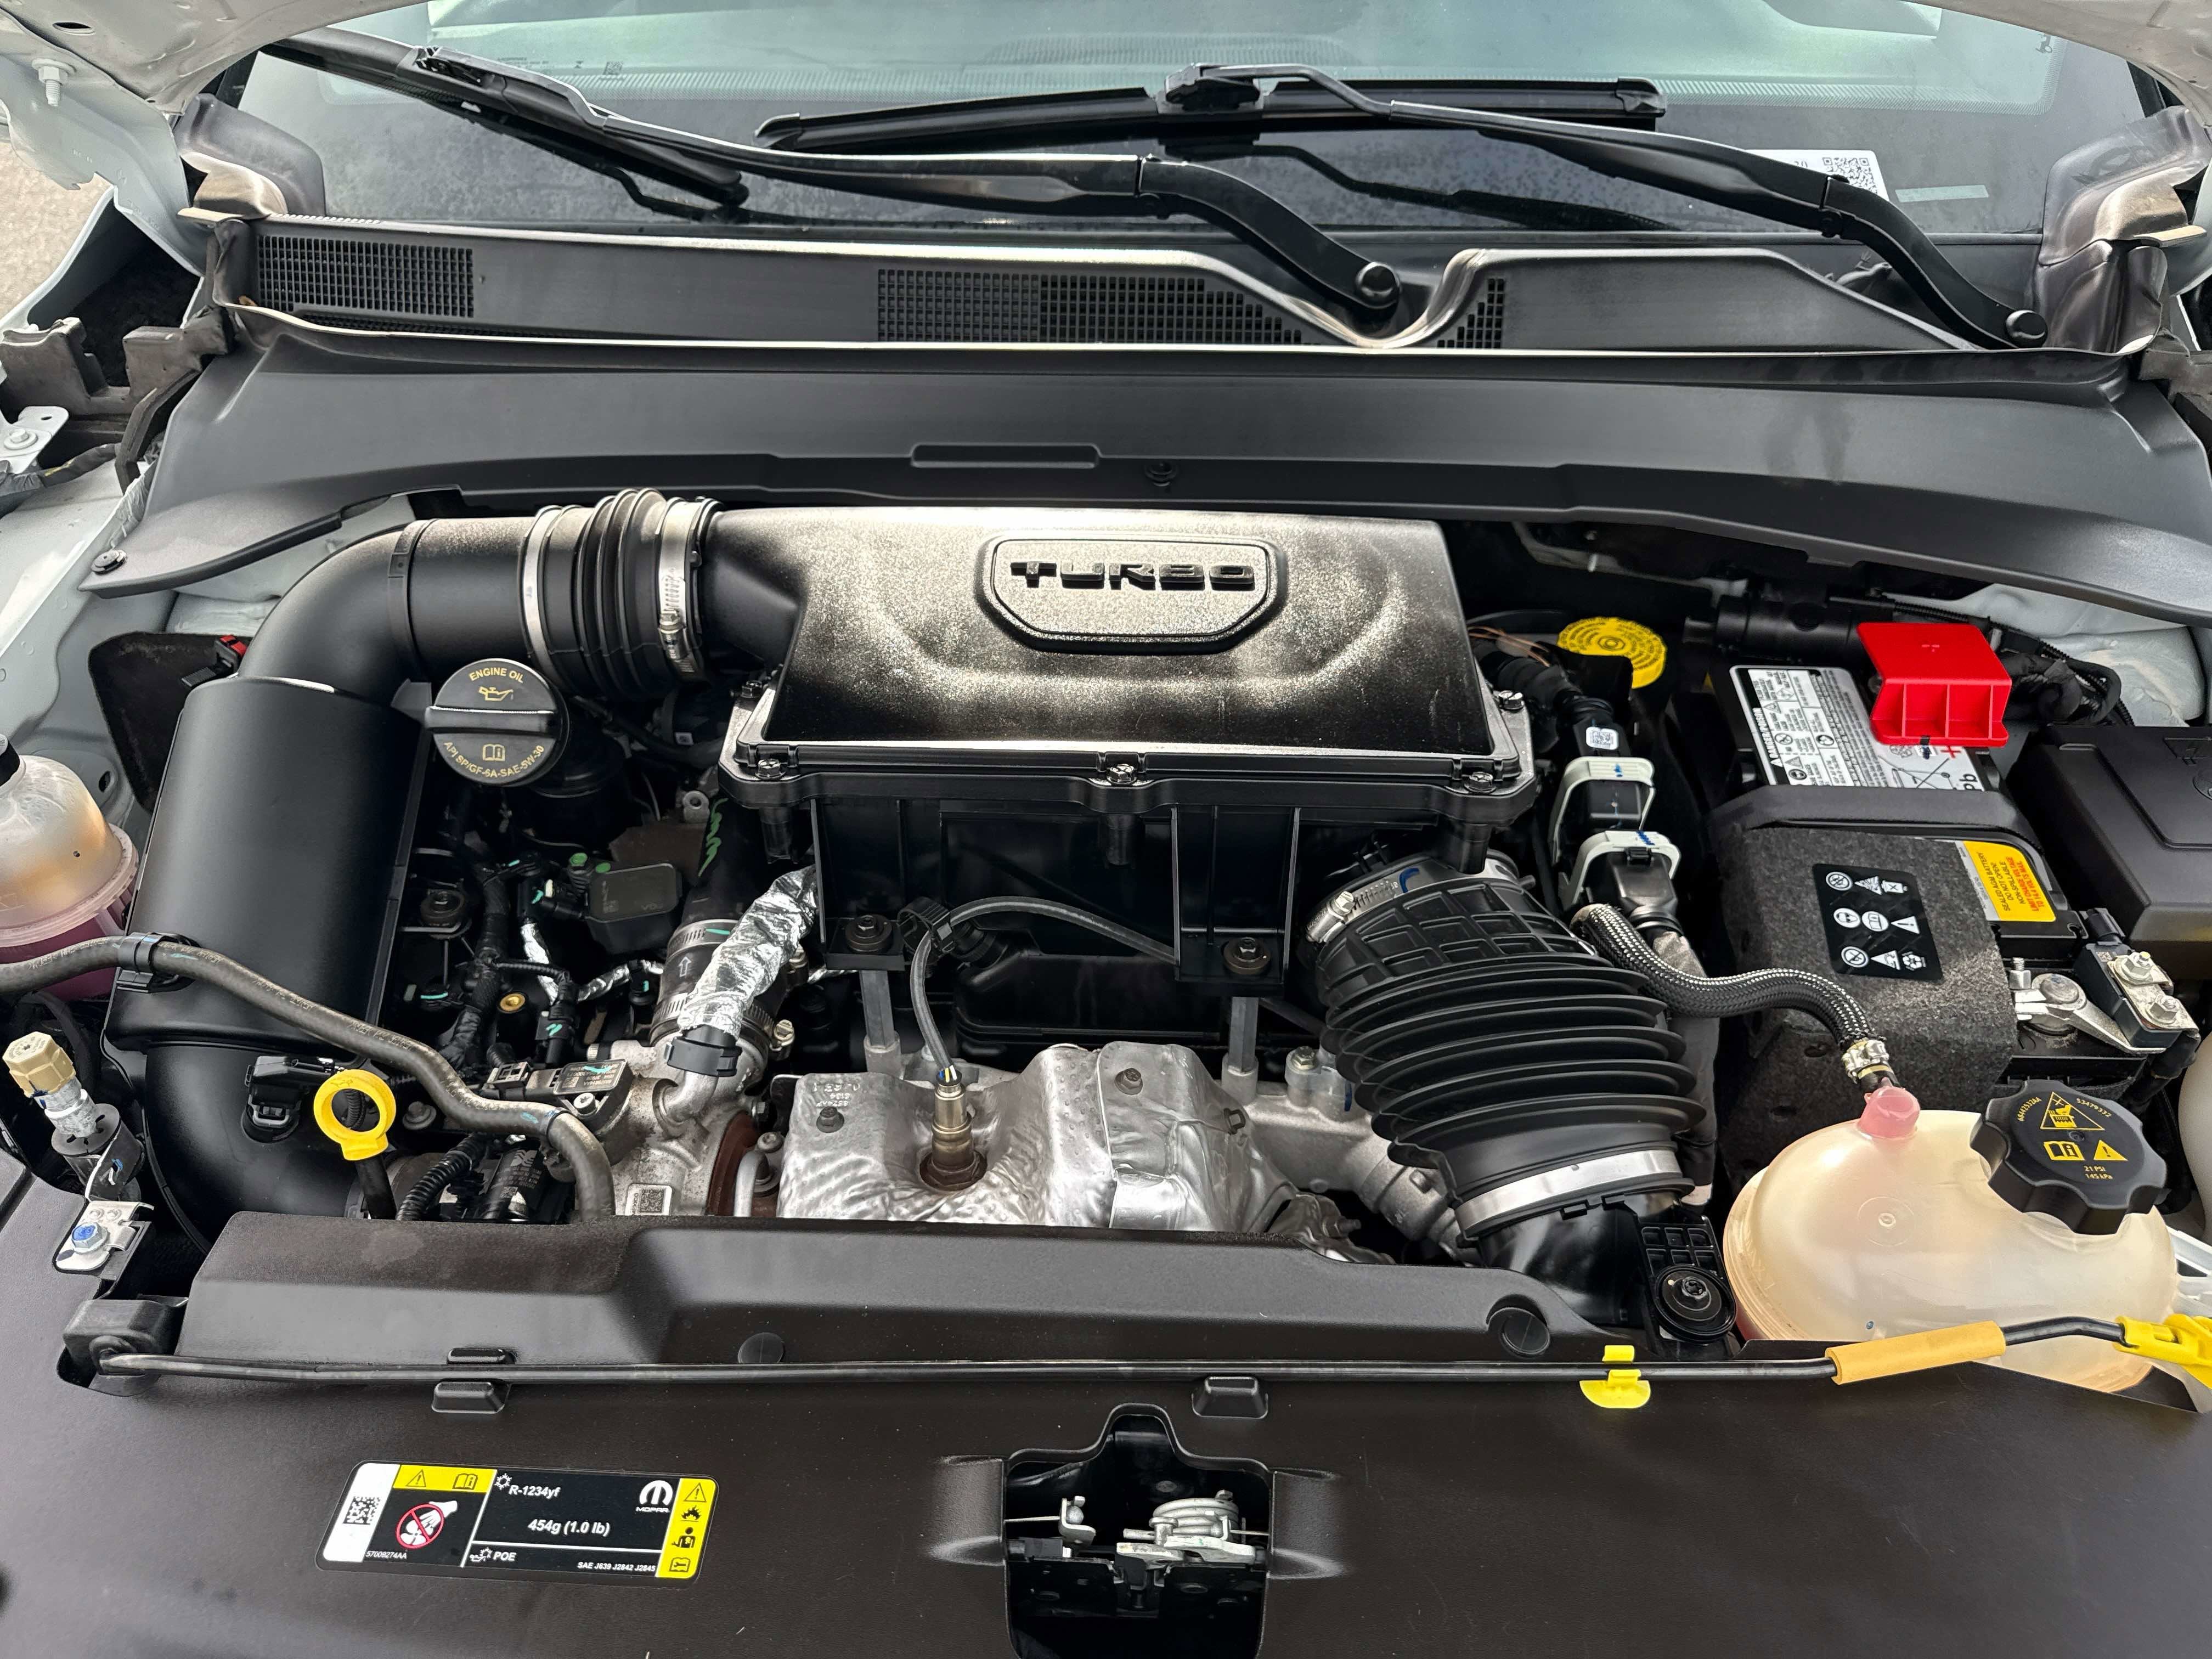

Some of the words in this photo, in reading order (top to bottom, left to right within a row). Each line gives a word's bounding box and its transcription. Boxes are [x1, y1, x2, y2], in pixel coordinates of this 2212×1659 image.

[1010, 561, 1255, 591] TURBO
[469, 667, 507, 681] ENGINE
[509, 670, 524, 684] OIL
[444, 742, 459, 758] API
[1978, 853, 1992, 875] BATTERY
[1999, 861, 2025, 905] NON-SPILLABLE
[1999, 879, 2008, 891] NOT
[1996, 890, 2010, 911] SEALED
[2005, 892, 2014, 900] DO
[509, 1485, 561, 1499] R-1234yf
[528, 1519, 561, 1535] 454g
[563, 1521, 589, 1535] (1.0
[591, 1522, 610, 1537] lb)
[493, 1551, 517, 1562] POE
